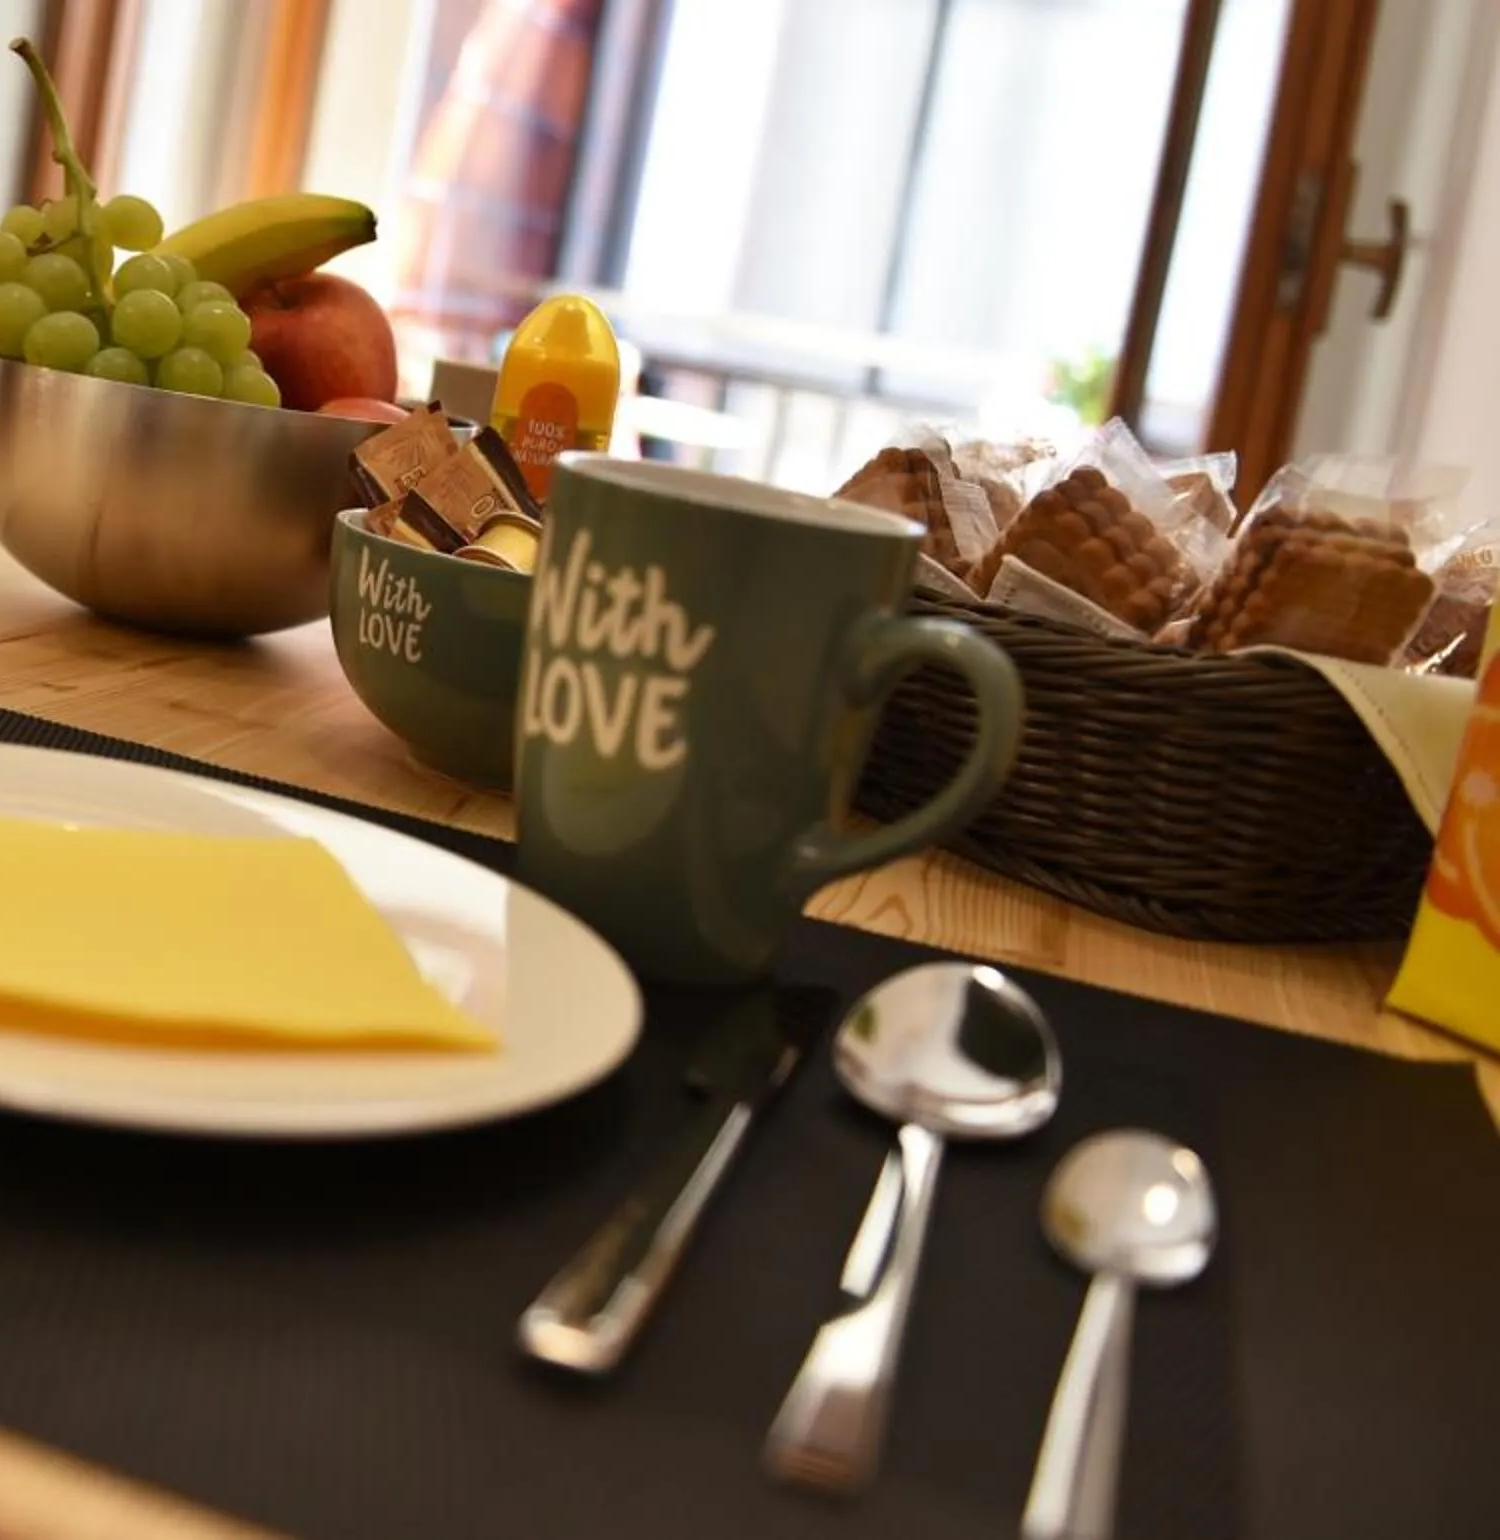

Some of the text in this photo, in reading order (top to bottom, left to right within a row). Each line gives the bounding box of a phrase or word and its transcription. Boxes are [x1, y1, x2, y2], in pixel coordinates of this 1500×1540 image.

[358, 545, 432, 622] With
[532, 514, 716, 671] With
[359, 606, 422, 663] LOVE
[524, 648, 691, 770] LOVE
